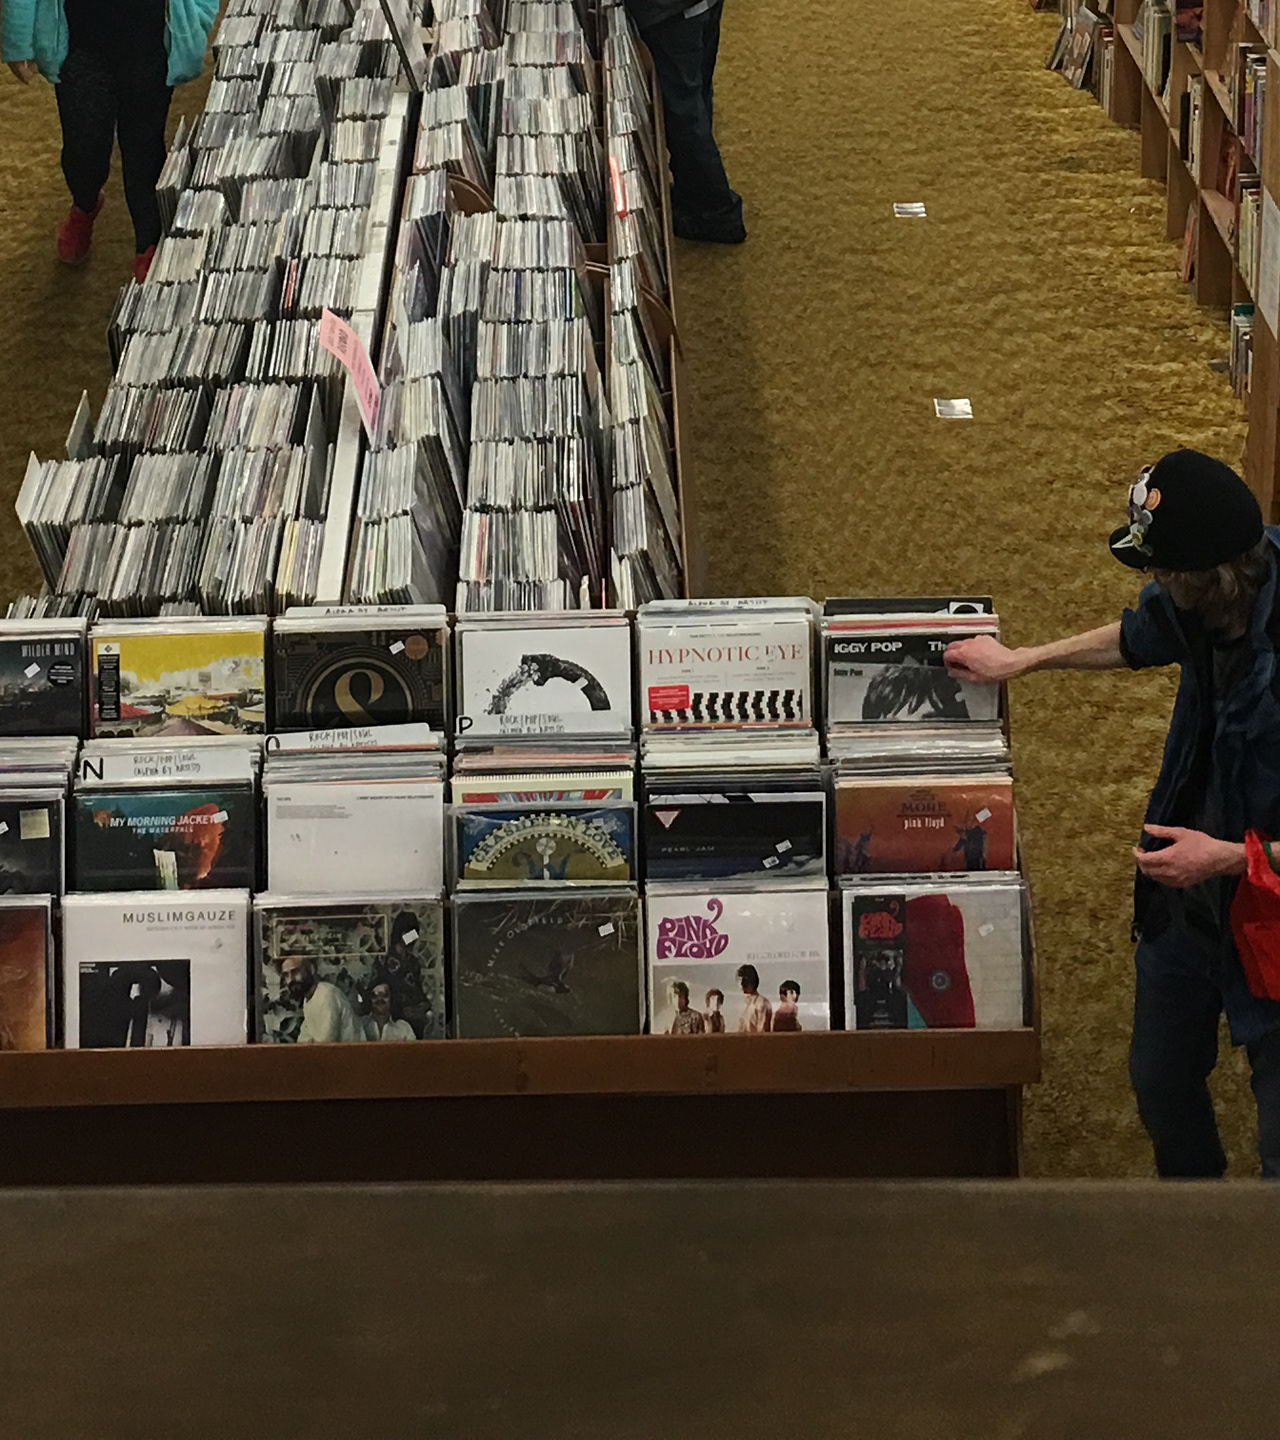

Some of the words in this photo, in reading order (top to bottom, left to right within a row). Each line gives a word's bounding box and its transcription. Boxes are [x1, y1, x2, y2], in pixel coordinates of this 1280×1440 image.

[21, 644, 51, 658] WILDER
[53, 642, 76, 656] MIND
[648, 646, 761, 665] HYPNOTIC
[834, 642, 868, 655] IGGY
[871, 641, 903, 653] POP
[459, 715, 474, 734] P
[83, 757, 104, 780] N
[901, 801, 947, 813] MORE
[110, 817, 126, 828] MY
[127, 815, 176, 828] MORNING
[177, 814, 217, 826] JACKET
[903, 816, 924, 830] pink
[925, 816, 945, 830] floyd
[149, 826, 195, 834] WATERFALL
[585, 825, 620, 859] LOVE
[123, 910, 236, 924] MUSLIMGAUZE
[657, 898, 724, 940] PINK
[488, 940, 506, 967] MIKE
[507, 916, 564, 939] OLDFIELD
[656, 934, 729, 960] FLOYD
